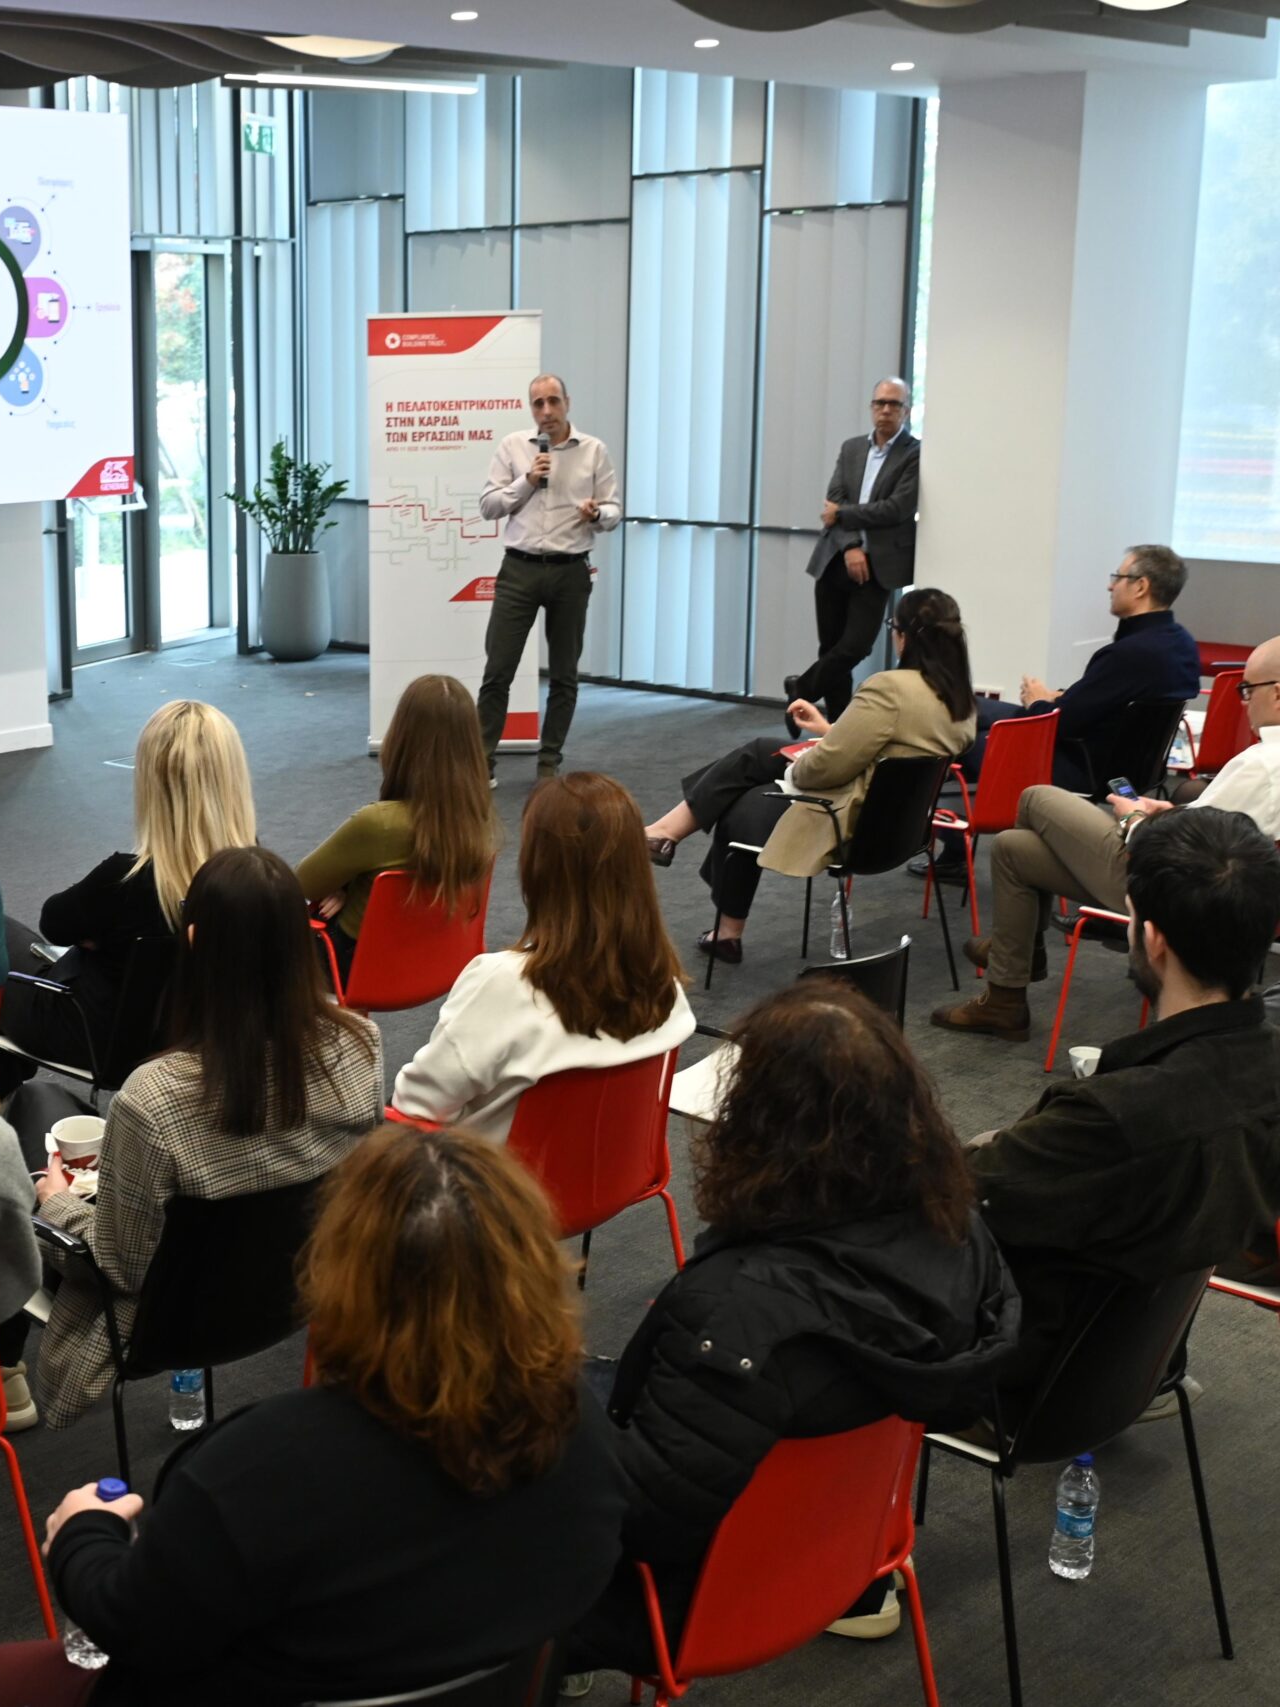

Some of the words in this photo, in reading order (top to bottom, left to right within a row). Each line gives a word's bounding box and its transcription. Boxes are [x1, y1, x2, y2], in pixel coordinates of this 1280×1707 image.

[385, 402, 394, 413] Η
[397, 398, 523, 413] ΠΕΛΑΤΟΚΕΝΤΡΙΚΟΤΗΤΑ
[385, 416, 415, 428] ΣΤΗΝ
[418, 415, 460, 428] ΚΑΡΔΙΑ
[385, 431, 408, 443] ΤΩΝ
[411, 430, 464, 443] ΕΡΓΑΣΙΩΝ
[468, 429, 493, 441] ΜΑΣ
